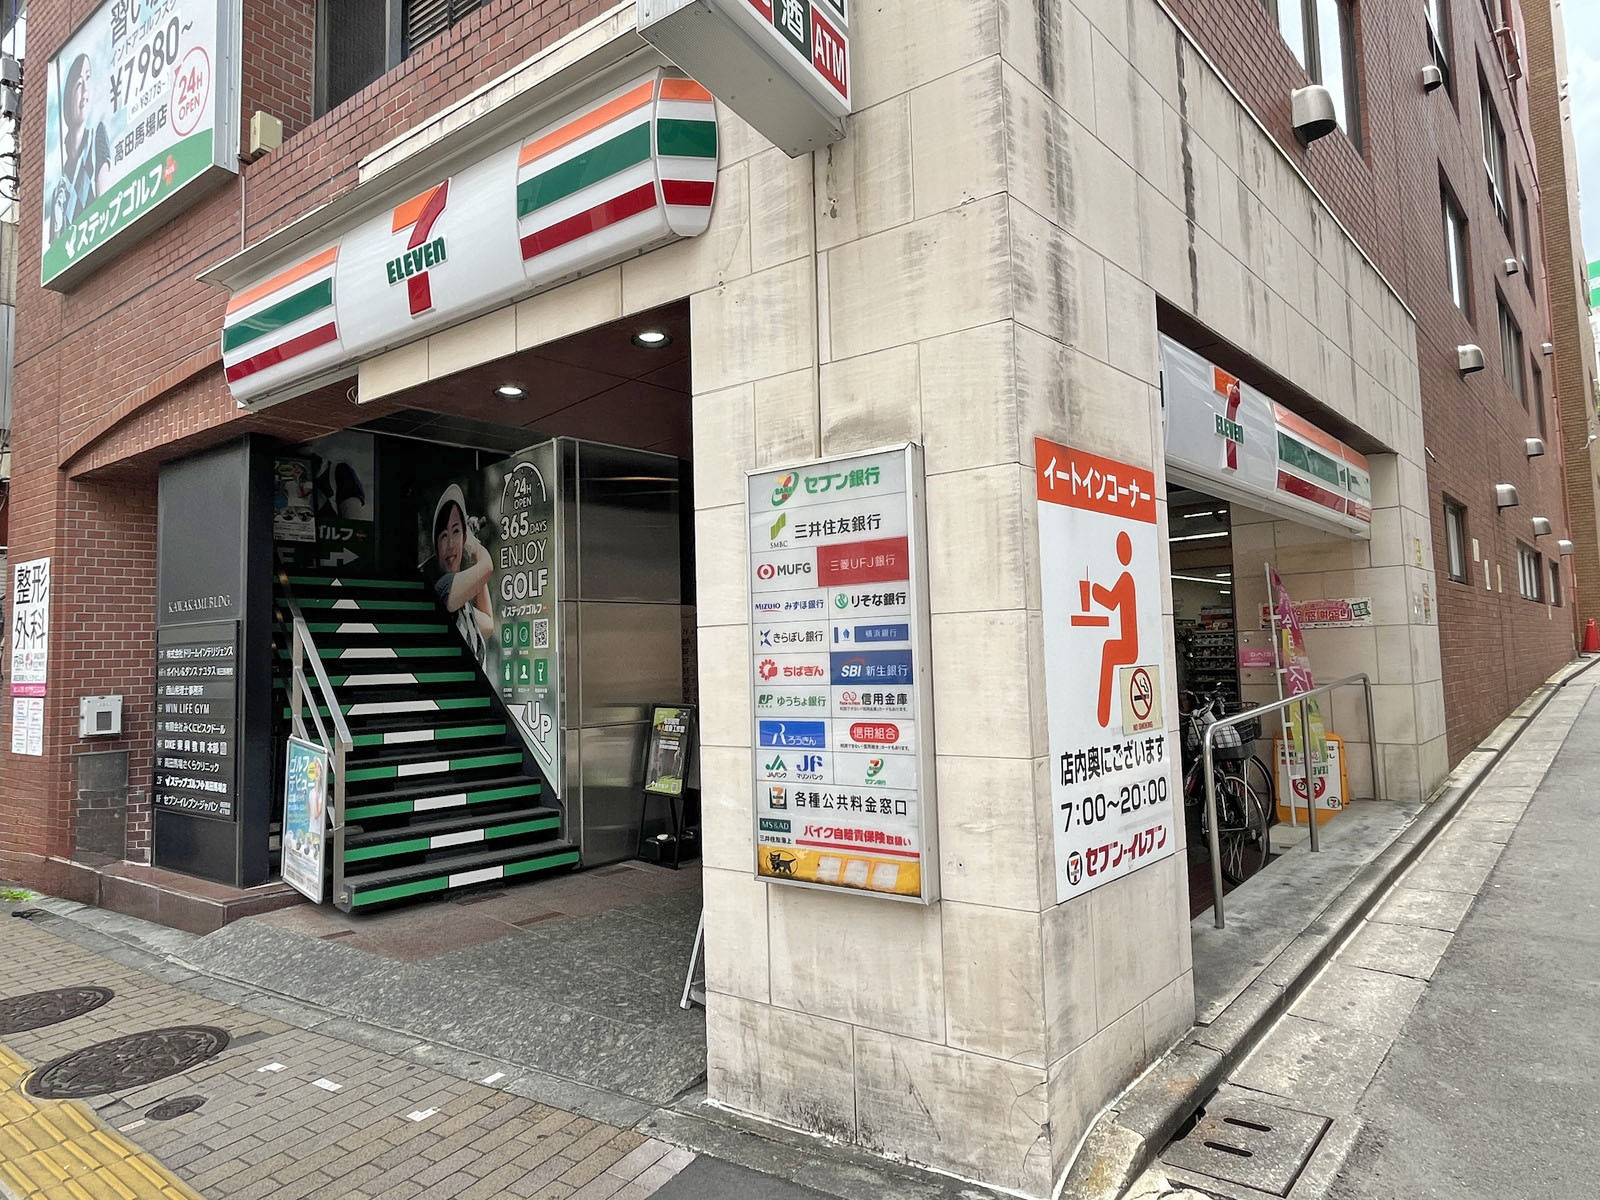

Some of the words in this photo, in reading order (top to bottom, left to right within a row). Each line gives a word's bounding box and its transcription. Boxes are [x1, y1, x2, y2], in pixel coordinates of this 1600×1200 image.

[815, 23, 845, 86] ATM
[178, 66, 202, 105] 24H
[178, 93, 201, 120] OPEN
[114, 104, 168, 165] 高田馬場店
[77, 164, 163, 251] ステップゴルフ
[391, 179, 449, 315] 7
[513, 477, 532, 498] 24H
[804, 466, 880, 494] セブン銀行
[1043, 456, 1151, 508] イートインコーナー
[513, 496, 532, 510] OPEN
[501, 512, 529, 541] 365
[529, 520, 548, 535] DAYS
[794, 513, 881, 539] 三井住友銀行
[500, 539, 548, 568] ENJOY
[770, 541, 788, 549] SMBC
[777, 562, 811, 577] MUFG
[830, 554, 896, 572] 三菱UFJ銀行
[16, 562, 47, 604] 整形
[501, 568, 548, 601] GOLF
[784, 599, 824, 611] みずほ銀行
[851, 591, 906, 608] りそな銀行
[15, 608, 46, 650] 外科
[773, 630, 824, 644] きらぼし銀行
[865, 626, 897, 638] 横浜銀行
[783, 665, 824, 677] ちばぎん
[841, 664, 862, 678] SBI
[865, 664, 908, 678] 新生銀行
[165, 703, 178, 714] WIN
[179, 703, 193, 714] LIFE
[194, 703, 210, 714] GYM
[777, 695, 826, 707] ゆうちょ銀行
[861, 692, 908, 705] 信用金庫
[527, 700, 552, 743] UP
[788, 735, 817, 746] ろうきん
[853, 726, 896, 740] 信用組合
[1060, 734, 1165, 787] 店内奥にございます
[796, 773, 824, 781] マリンバンク
[794, 791, 908, 816] 各種公共料金窓口
[761, 820, 790, 831] MS&AD
[804, 825, 912, 847] バイク自賠責保険取扱い
[760, 834, 792, 845] 三井住友海上
